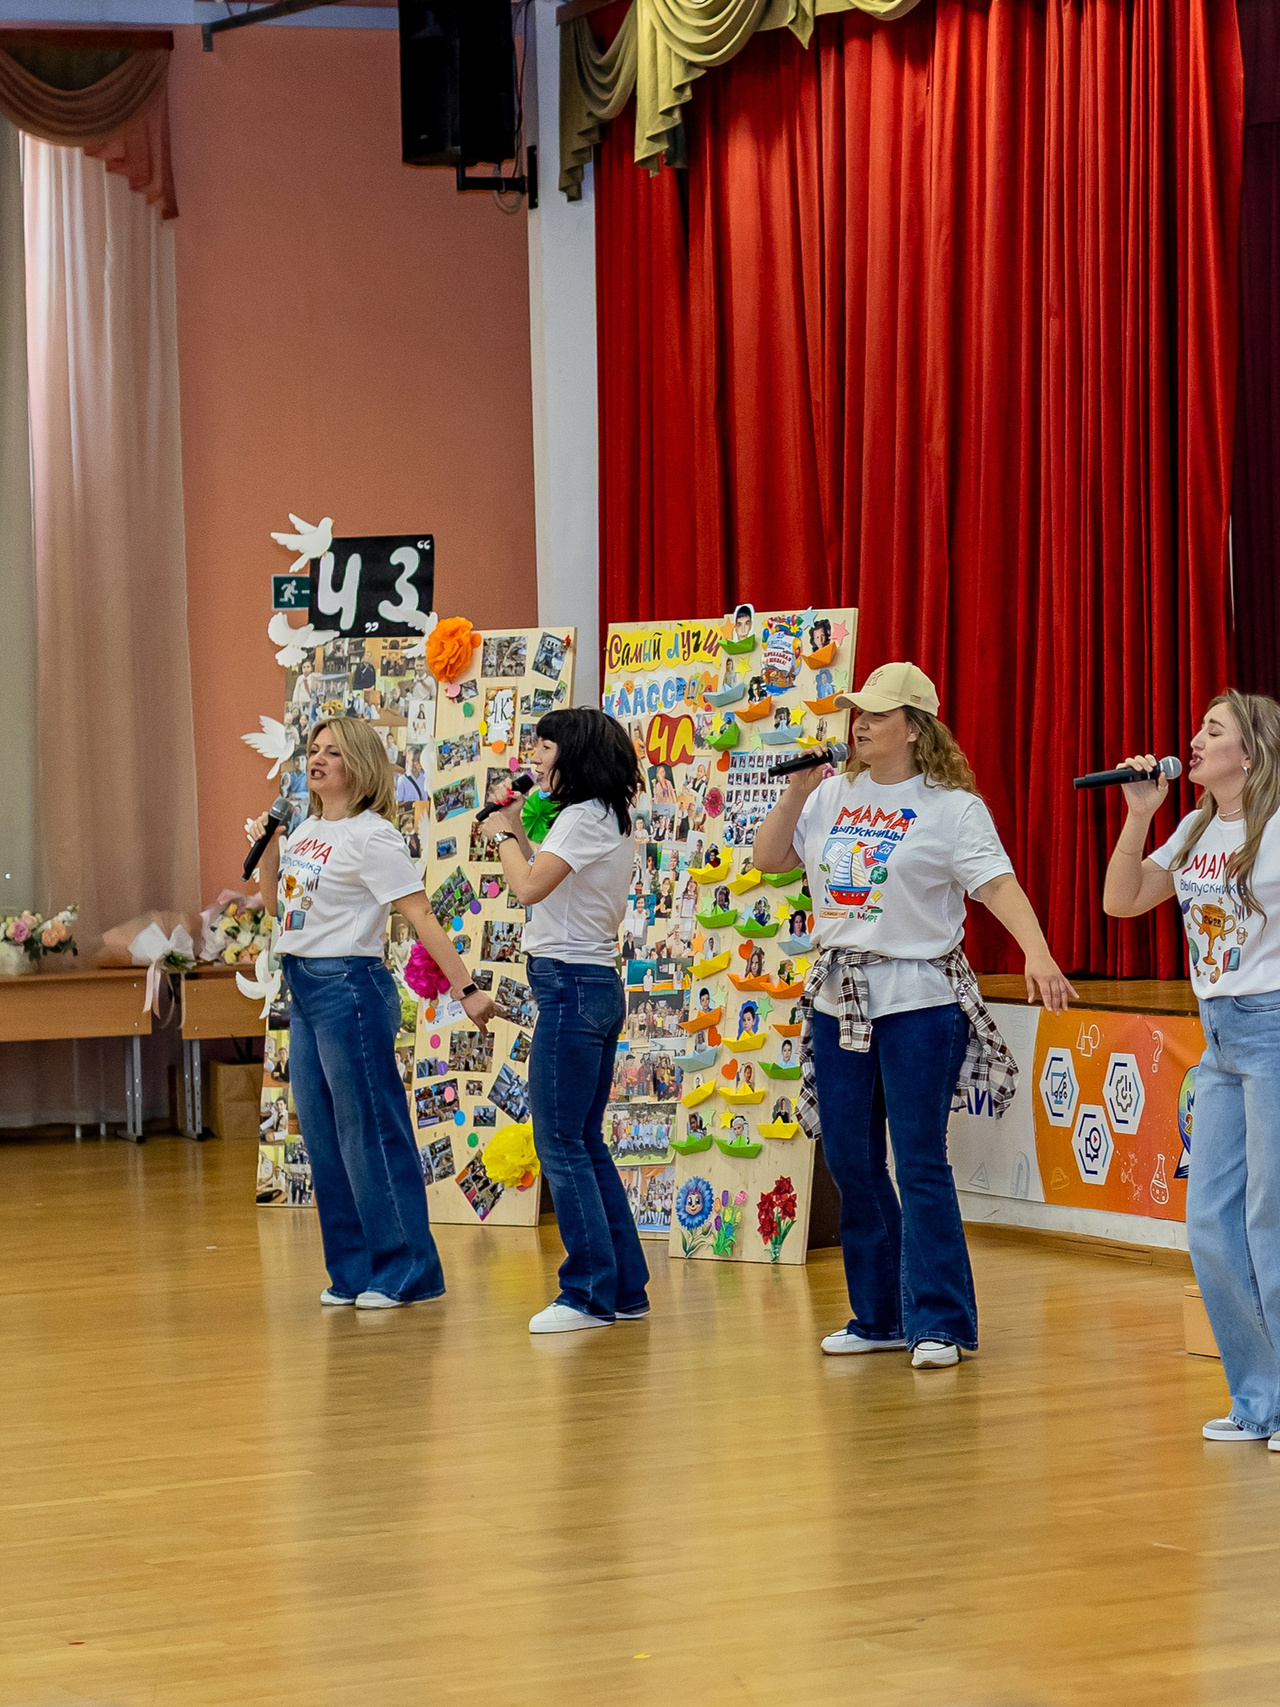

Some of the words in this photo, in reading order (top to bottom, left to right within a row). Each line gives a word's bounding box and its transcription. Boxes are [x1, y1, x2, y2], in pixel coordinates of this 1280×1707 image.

[608, 631, 662, 669] Самый
[666, 629, 722, 662] лучш
[834, 804, 911, 832] МАМА
